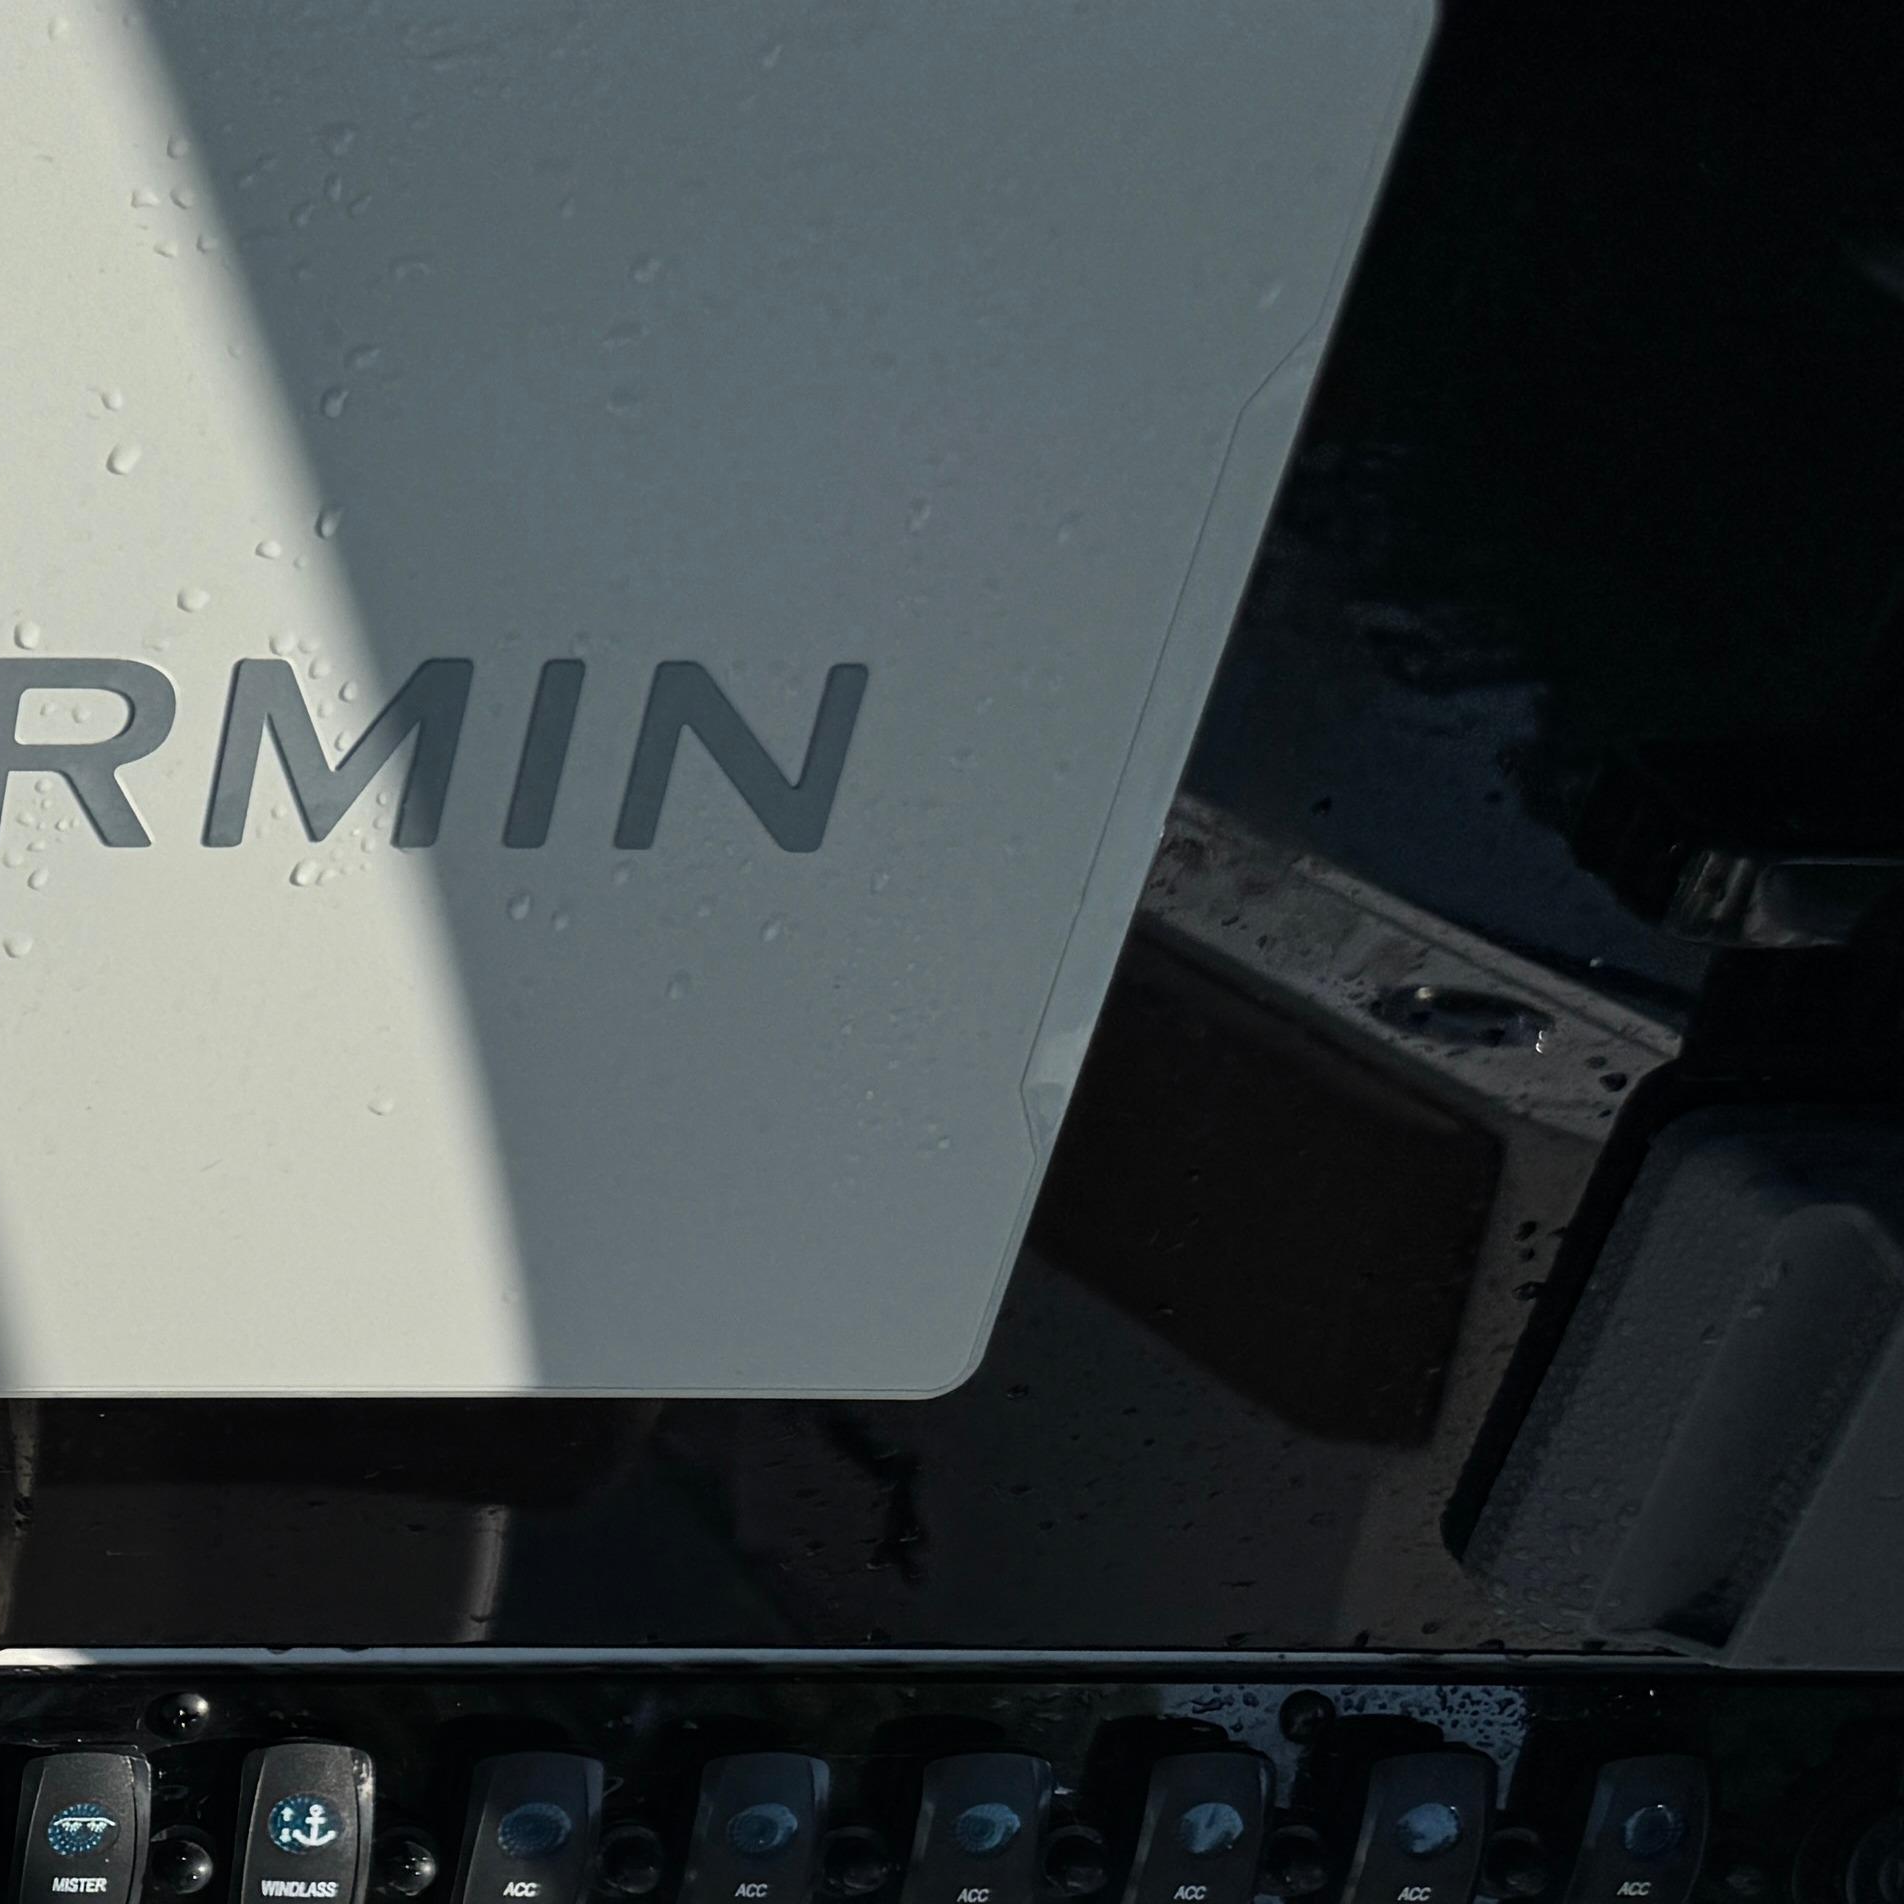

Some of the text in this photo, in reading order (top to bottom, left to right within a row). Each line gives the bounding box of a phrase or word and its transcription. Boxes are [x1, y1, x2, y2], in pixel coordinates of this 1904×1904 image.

[52, 1877, 107, 1893] MISTER
[261, 1880, 338, 1898] WINDLASS
[503, 1881, 539, 1898] ACC
[734, 1883, 769, 1898] ACC
[1617, 1881, 1652, 1896] ACC
[957, 1889, 990, 1903] ACC
[1173, 1886, 1208, 1900] ACC
[1398, 1886, 1432, 1901] ACC
